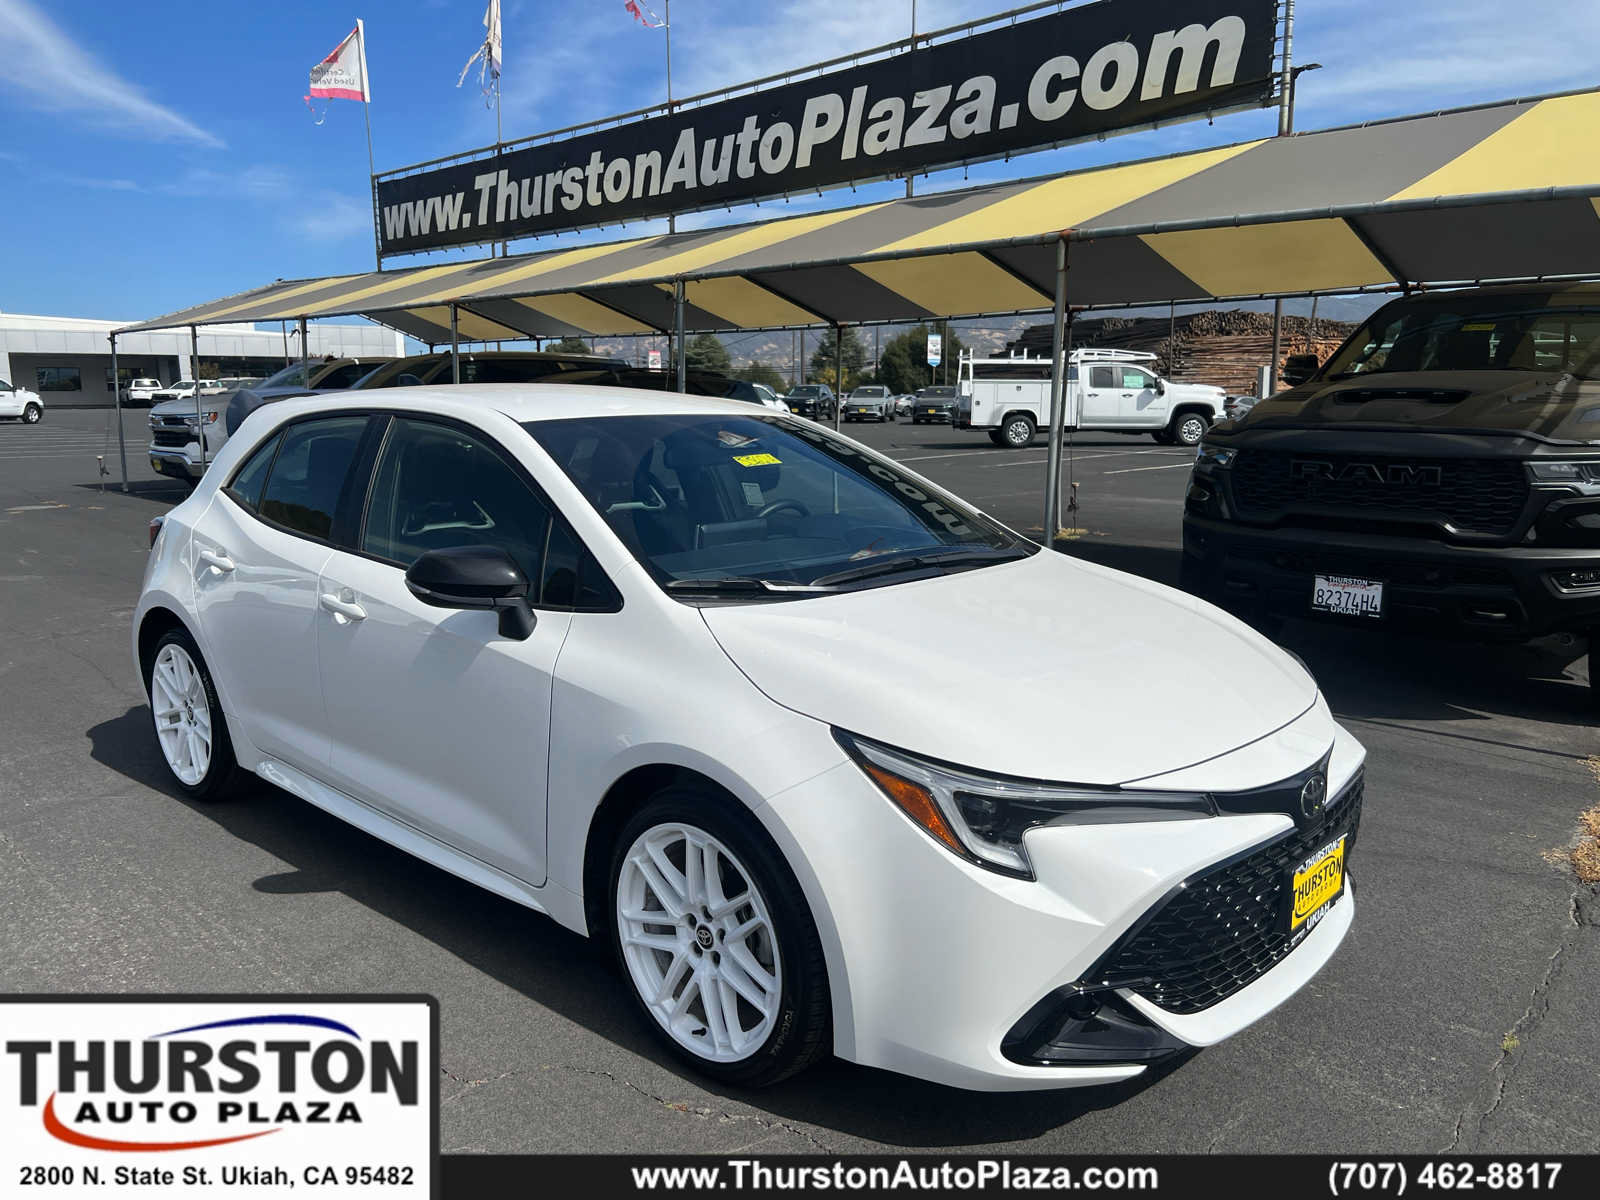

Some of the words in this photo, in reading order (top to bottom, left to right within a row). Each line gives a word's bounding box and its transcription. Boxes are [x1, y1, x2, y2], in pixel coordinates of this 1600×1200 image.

[383, 15, 1246, 241] www.ThurstonAutoPlaza.com
[1289, 458, 1442, 486] RAM
[1328, 576, 1368, 586] THURSTON
[1316, 588, 1379, 611] 82374H4
[1330, 604, 1360, 616] UKIAH
[1293, 855, 1343, 911] THURSTON
